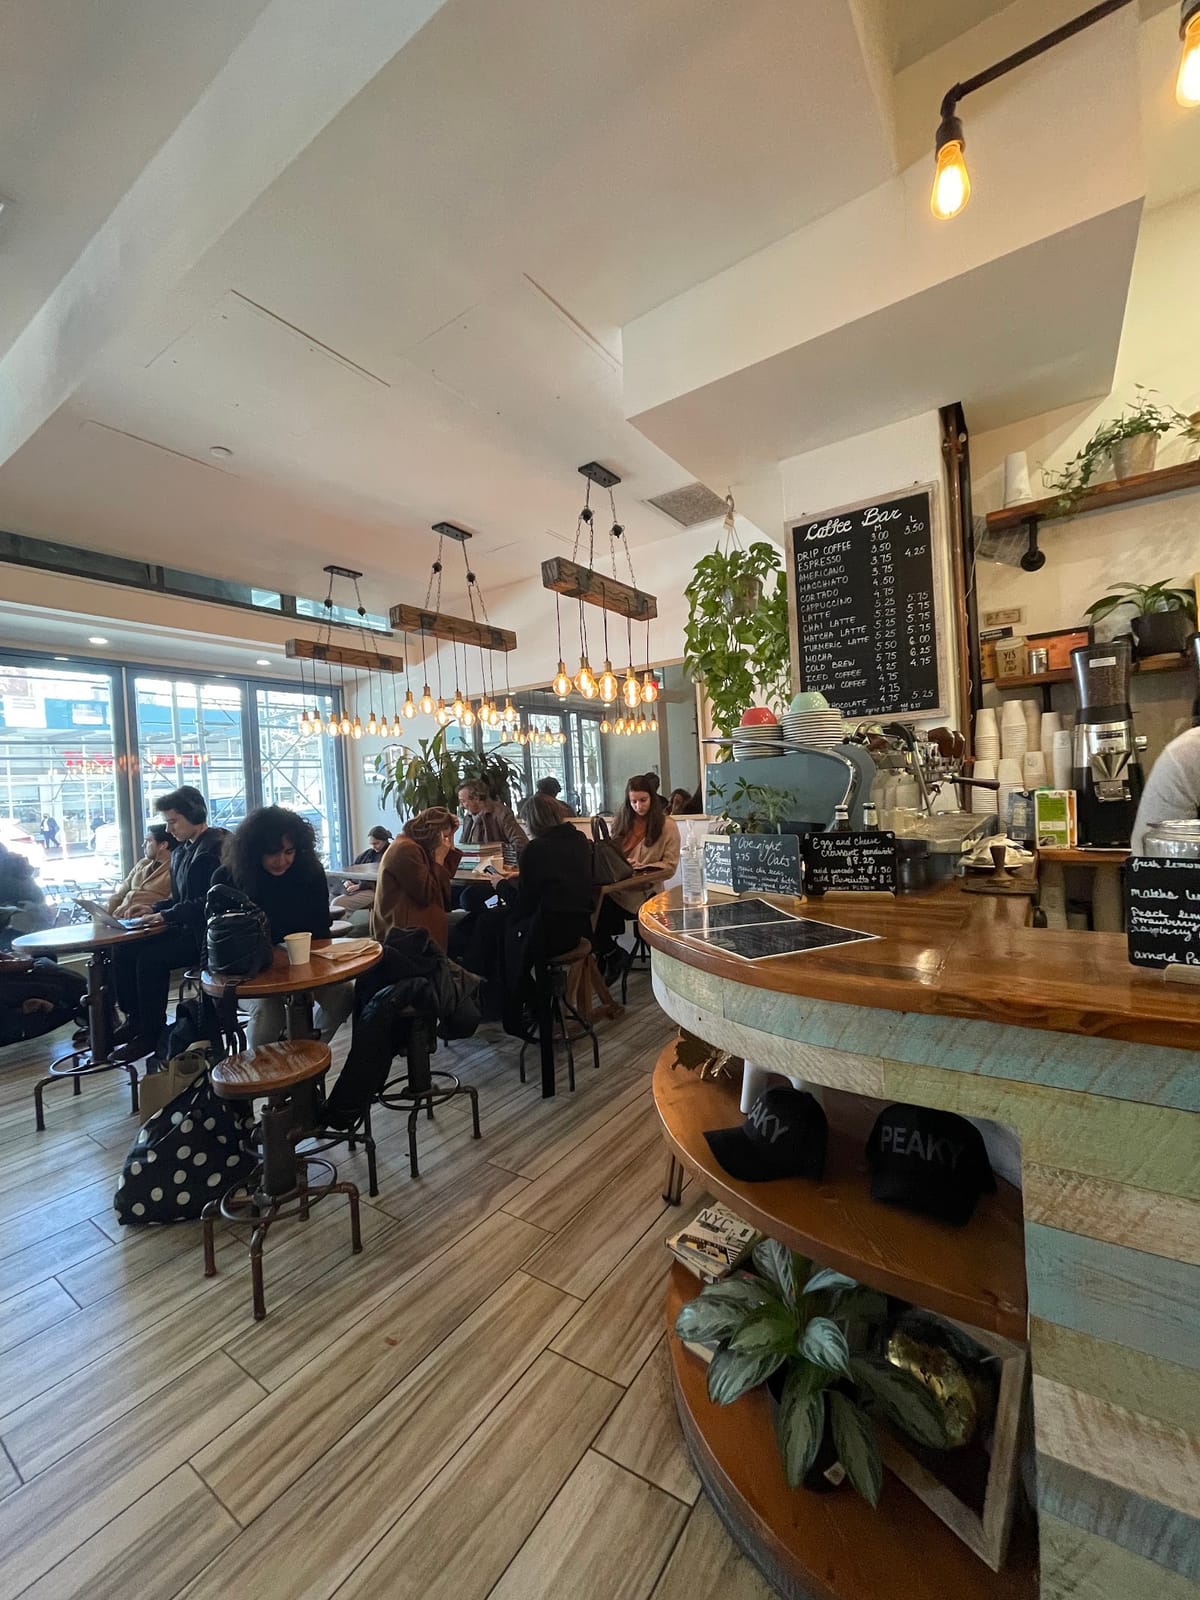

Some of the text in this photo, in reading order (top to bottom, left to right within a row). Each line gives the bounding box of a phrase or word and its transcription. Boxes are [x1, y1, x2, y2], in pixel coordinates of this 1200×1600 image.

[804, 508, 902, 541] Coffee Bar
[910, 515, 917, 523] L
[797, 522, 924, 562] DRIP COFFEE 3.00 3.50
[798, 555, 841, 572] ESPRESSO
[799, 565, 845, 583] AMERICANO
[904, 545, 927, 557] 4.25
[800, 575, 848, 593] MACCHIATO
[800, 588, 839, 602] CORTADO
[801, 597, 852, 613] CAPPUCCINO
[802, 611, 831, 622] LATTE
[803, 623, 823, 633] CHAI
[830, 616, 856, 628] LATTE
[804, 632, 833, 643] MATCHA
[841, 625, 867, 637] LATTE
[803, 641, 842, 652] TURMERIC
[848, 635, 870, 645] LATTE
[805, 653, 833, 664] MOCHA
[805, 664, 826, 673] COLD
[832, 659, 855, 669] BREW
[806, 674, 828, 683] ICED
[834, 669, 862, 679] COFFEE
[841, 679, 867, 689] COFFEE
[831, 699, 868, 709] HOCOLATE
[812, 837, 834, 850] Egg
[835, 837, 851, 846] and
[747, 1097, 789, 1144] AKY
[880, 1125, 967, 1170] PEAKY
[700, 1210, 734, 1233] NYC
